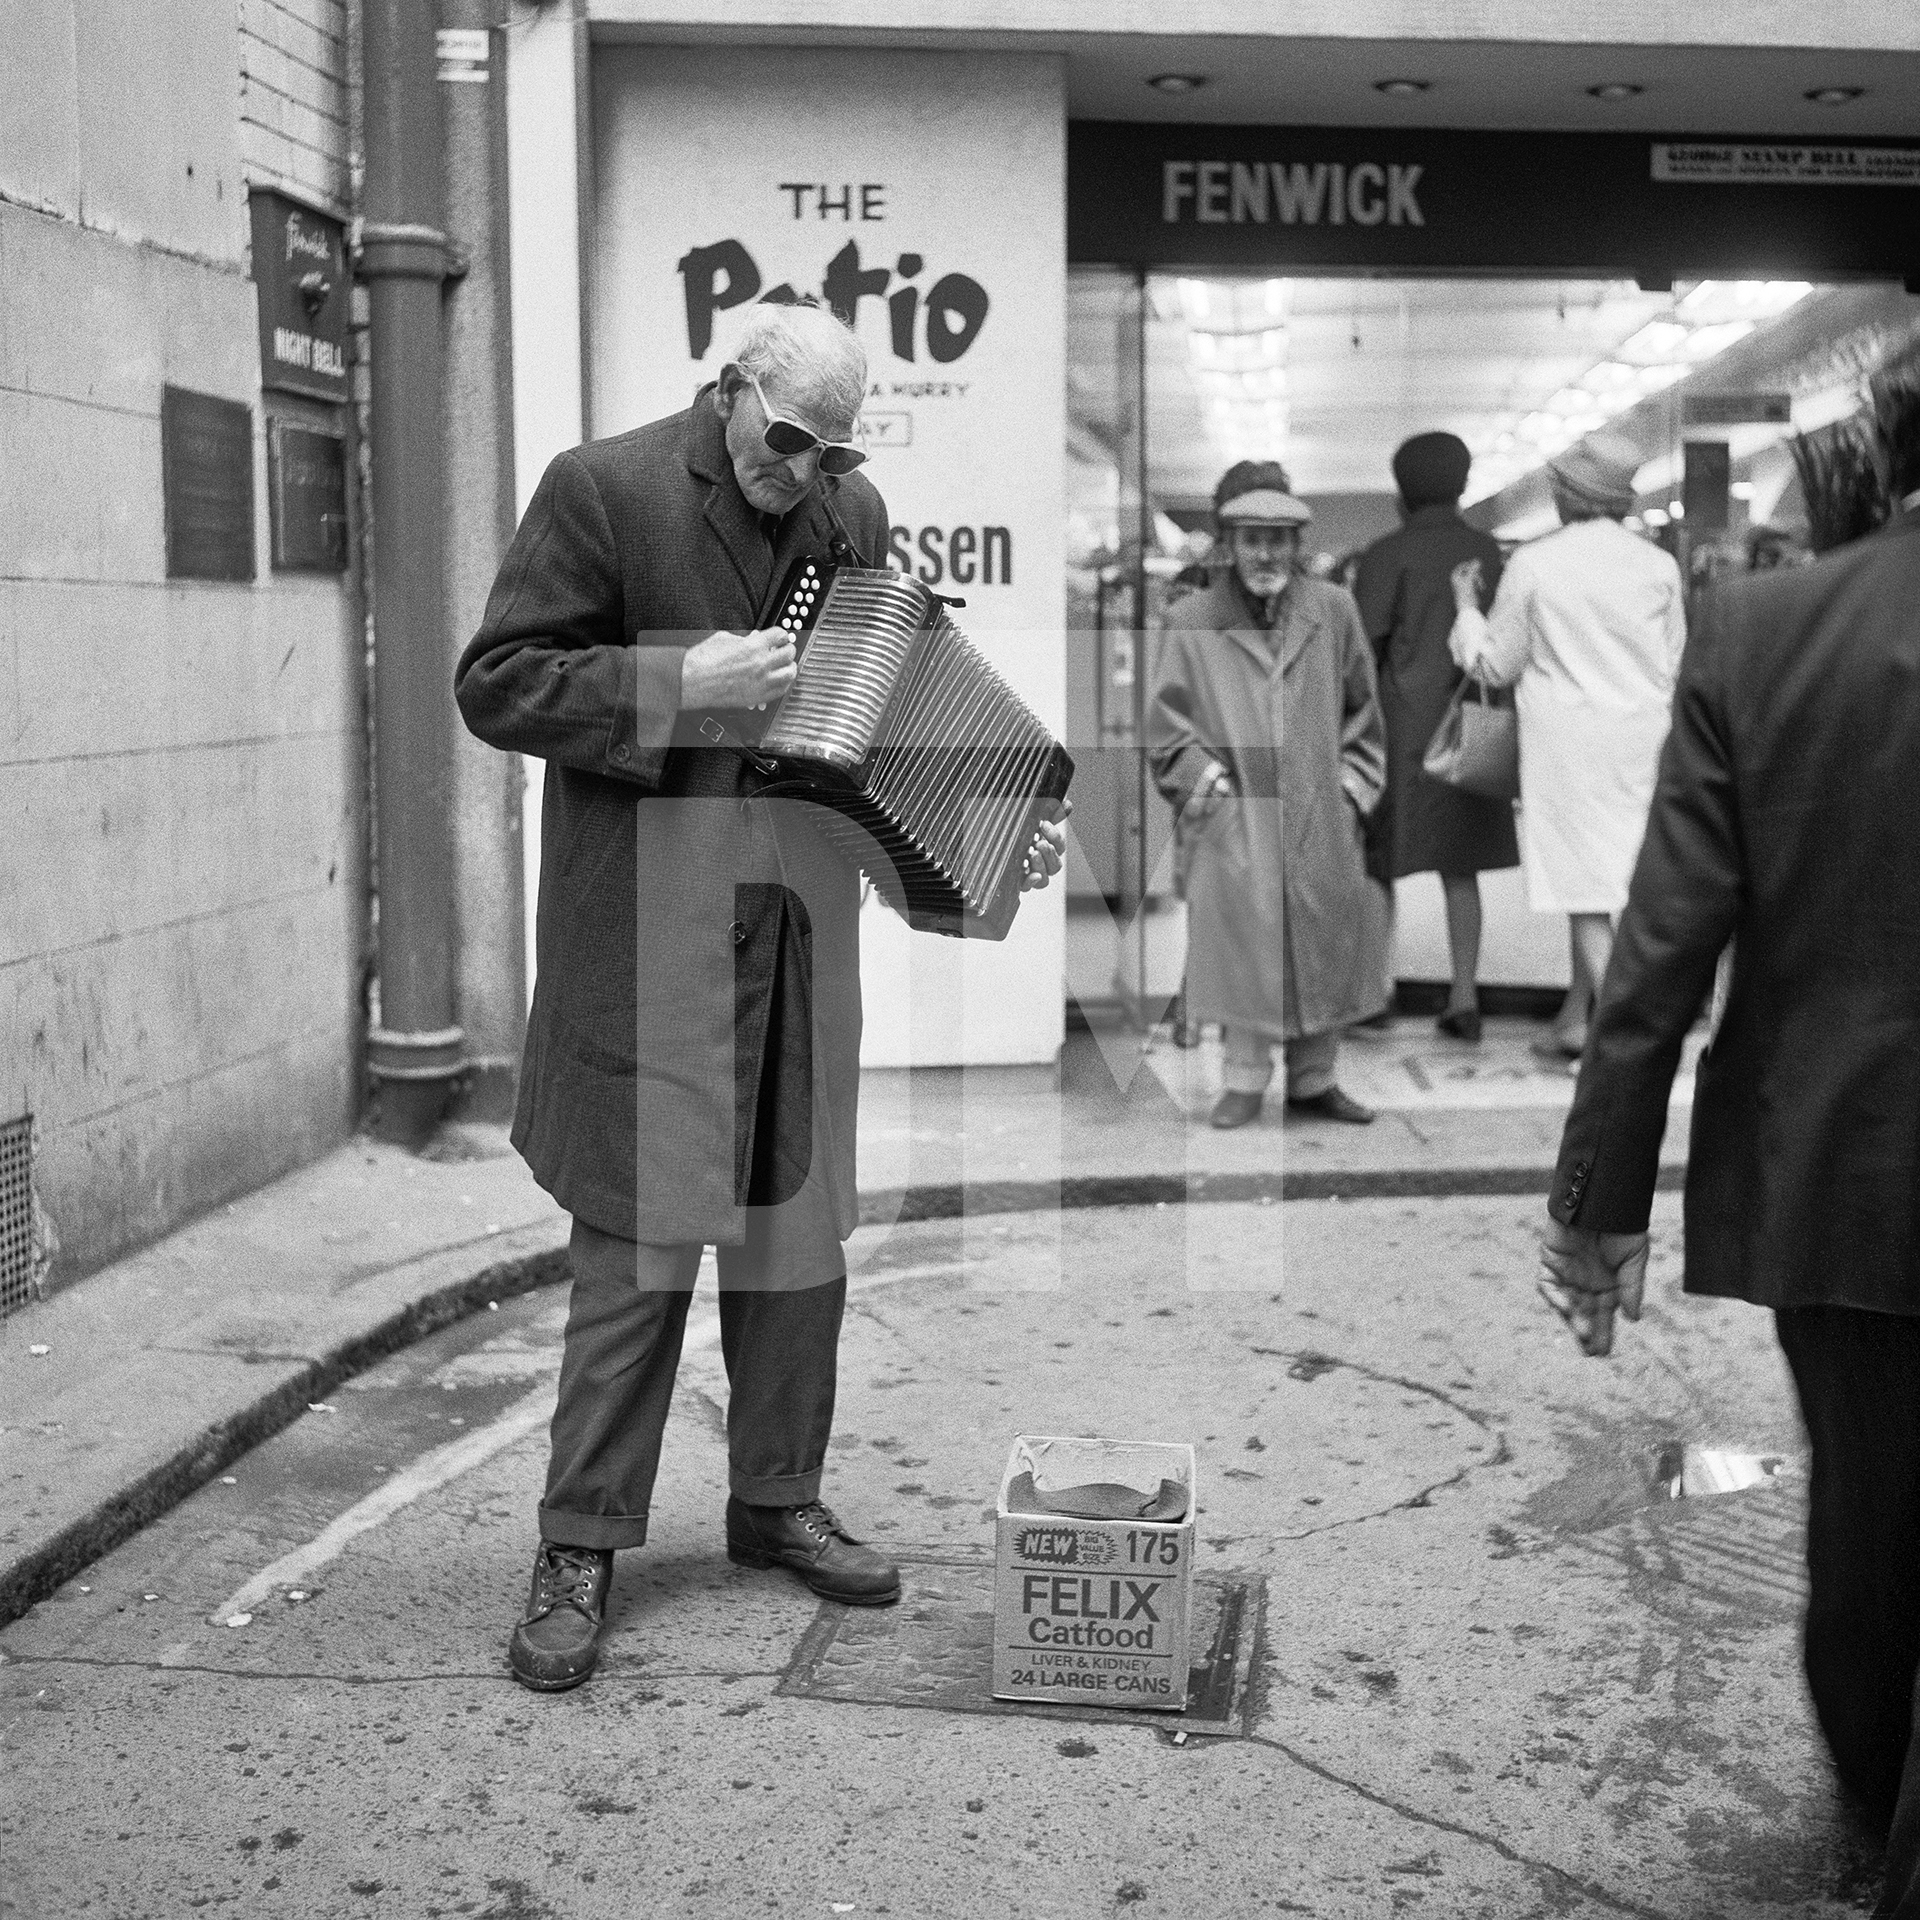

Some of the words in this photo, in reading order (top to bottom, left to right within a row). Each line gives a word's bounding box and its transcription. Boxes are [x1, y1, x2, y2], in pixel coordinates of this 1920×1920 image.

[779, 183, 885, 222] THE
[1163, 160, 1425, 226] FENWICK
[273, 327, 313, 369] NIGHT
[312, 338, 346, 378] BELL
[892, 382, 971, 398] HURRY
[1023, 1532, 1073, 1556] NEW
[1084, 1536, 1099, 1544] BIG
[1126, 1530, 1179, 1565] 175
[1022, 1575, 1161, 1623] FELIX
[1028, 1616, 1154, 1650] Catfood
[1031, 1653, 1074, 1668] LIVER
[1076, 1656, 1089, 1669] &
[1092, 1657, 1151, 1672] KIDNEY
[1011, 1669, 1036, 1686] 24
[1040, 1671, 1108, 1691] LARGE
[1114, 1674, 1172, 1695] CANS
